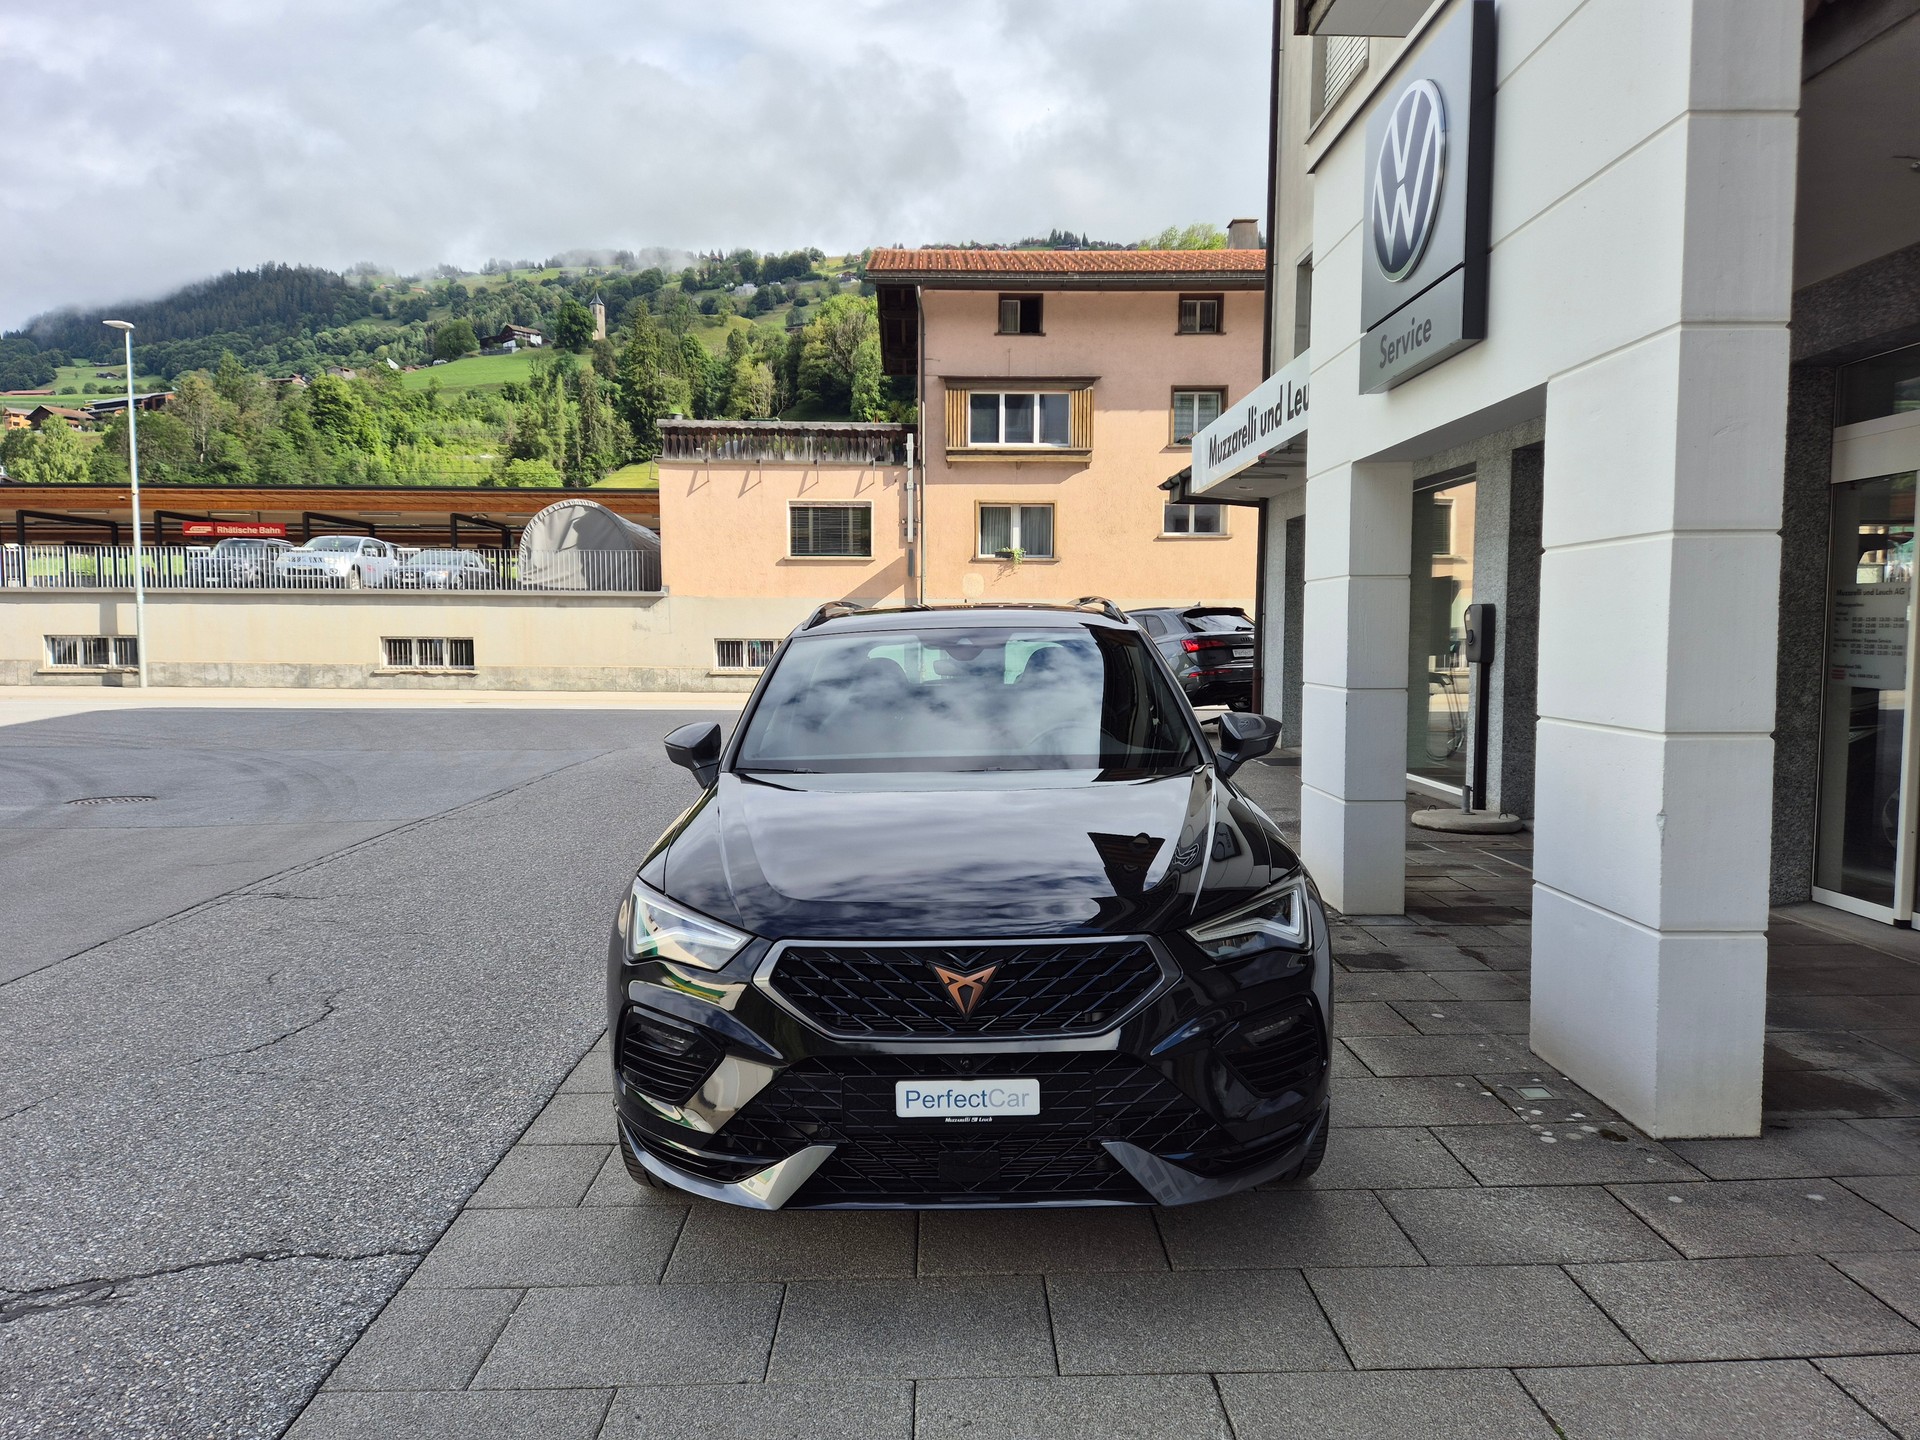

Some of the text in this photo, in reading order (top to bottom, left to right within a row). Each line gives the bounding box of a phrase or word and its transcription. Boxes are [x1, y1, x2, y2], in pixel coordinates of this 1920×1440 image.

[1379, 316, 1433, 369] Service
[1208, 405, 1257, 469] Muzzarelli
[1260, 384, 1284, 437] und
[217, 526, 281, 534] Rhätische Bahn
[1894, 587, 1905, 595] AG
[905, 1088, 1030, 1109] PerfectCar
